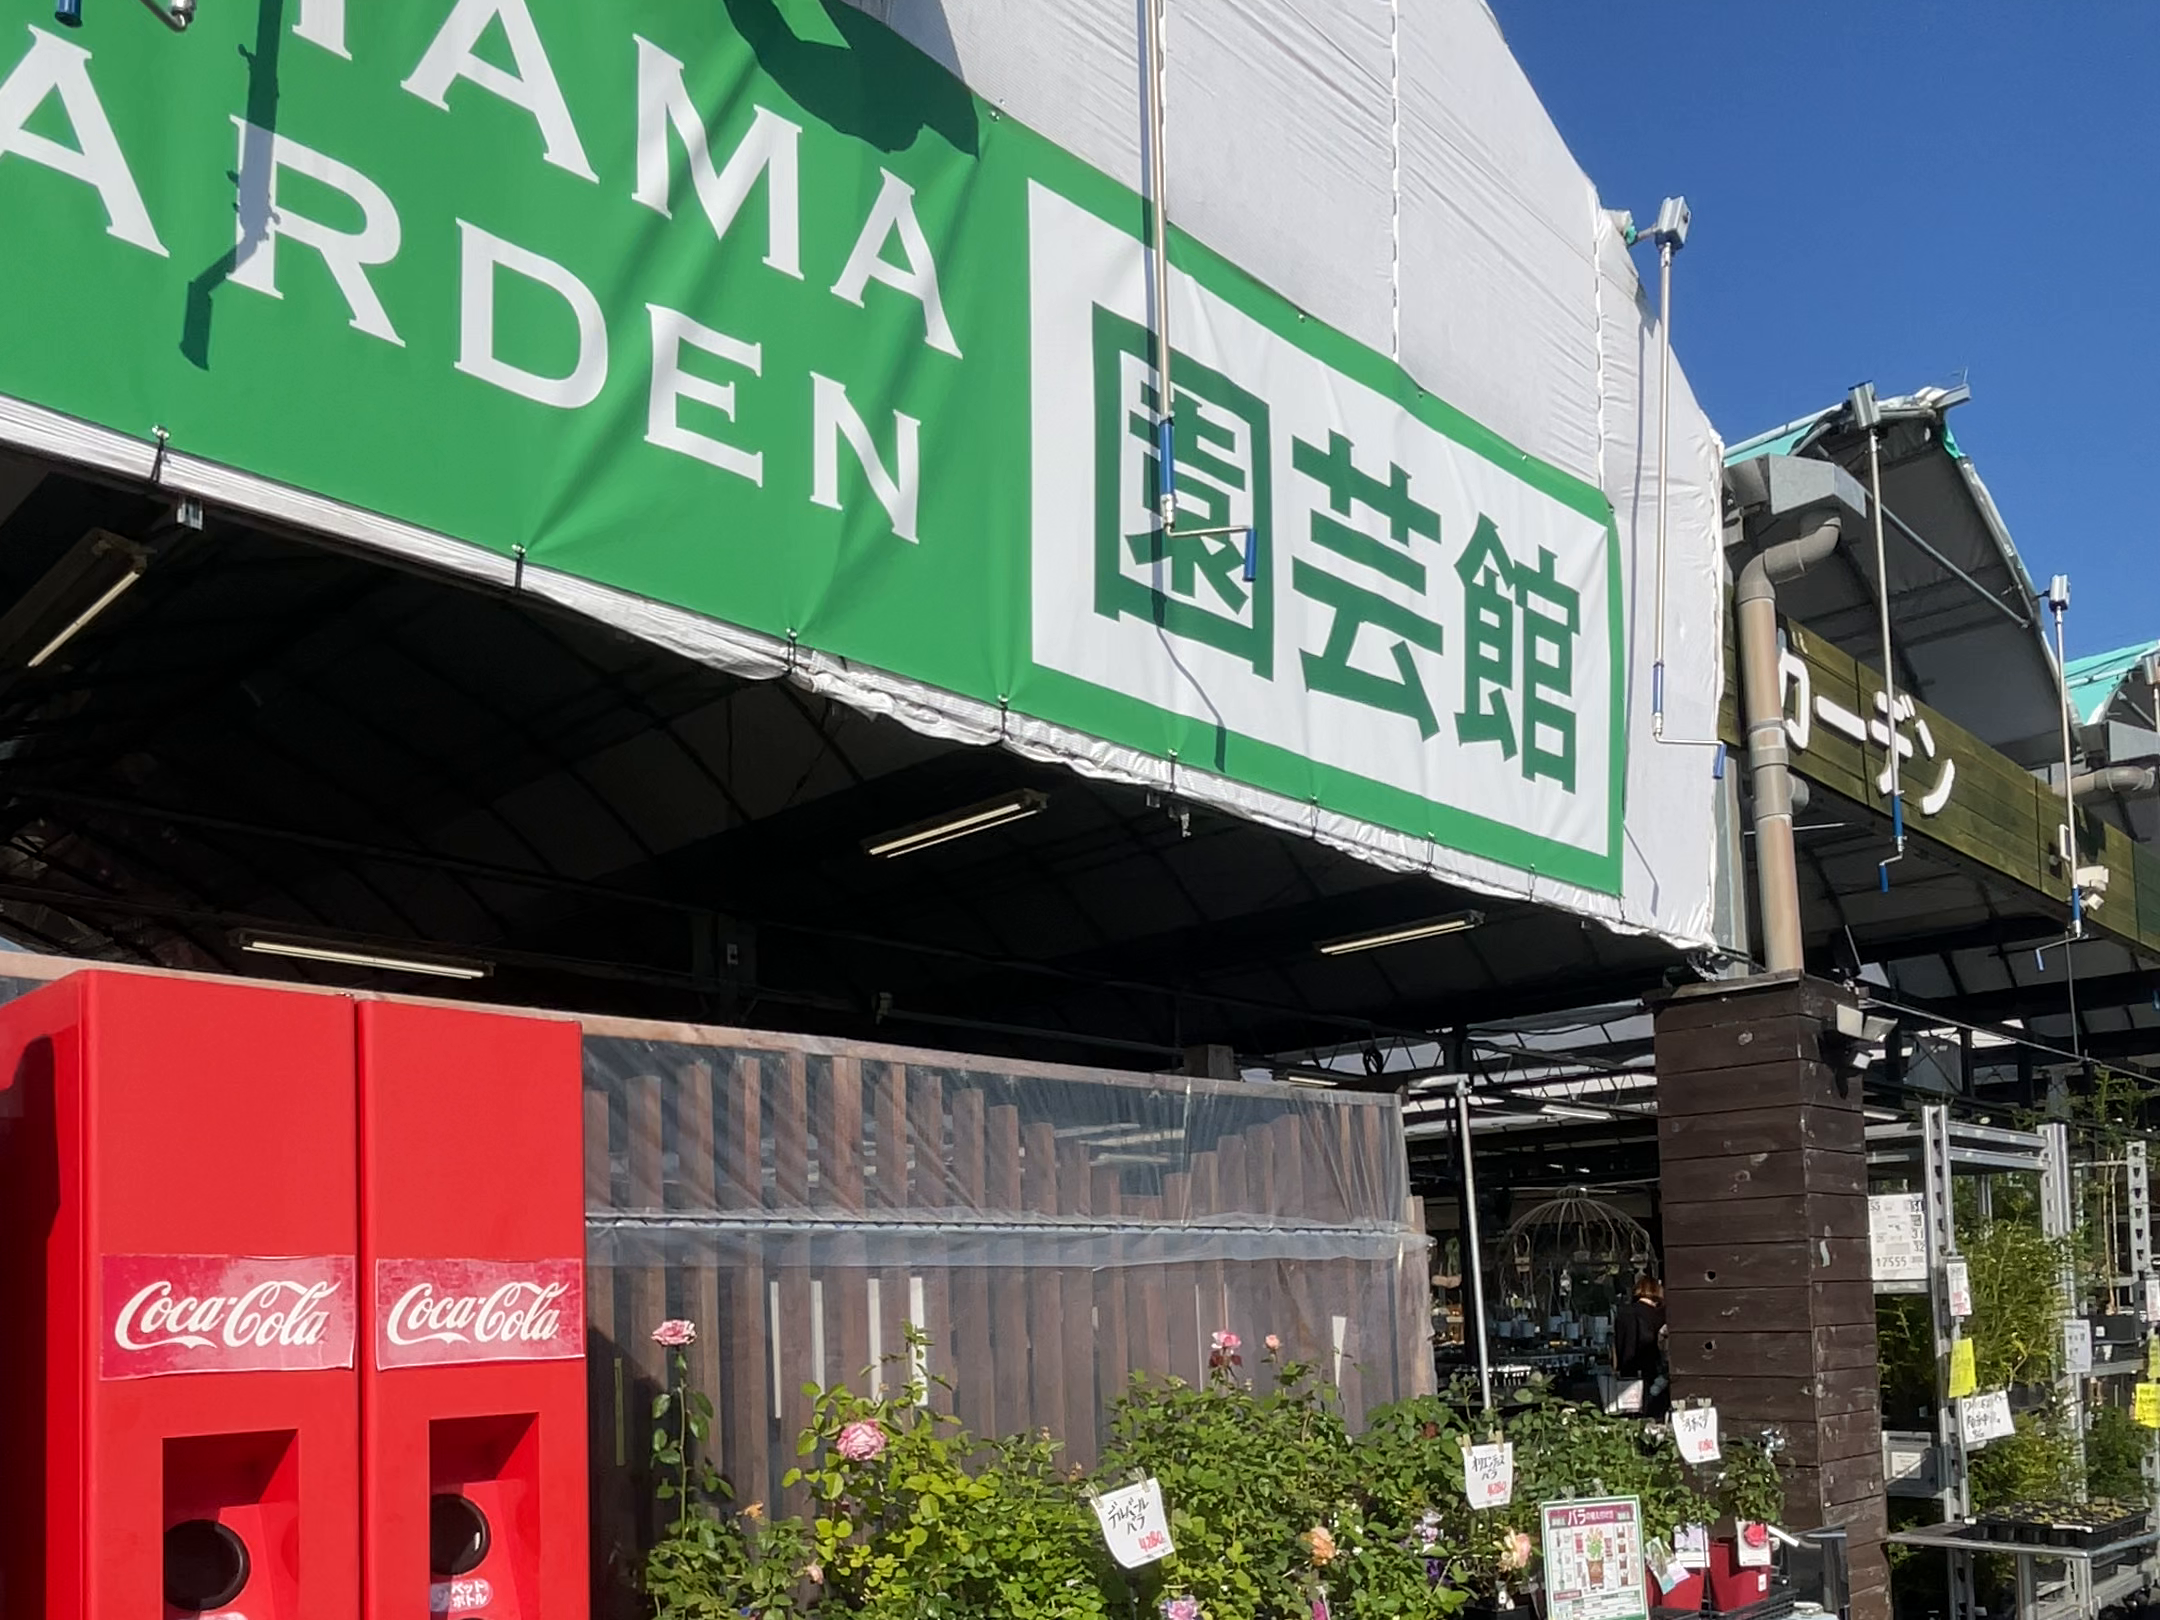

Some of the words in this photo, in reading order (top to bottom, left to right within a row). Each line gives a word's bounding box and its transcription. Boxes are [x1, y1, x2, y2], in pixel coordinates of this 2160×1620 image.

[1092, 301, 1581, 795] 園芸館
[115, 1280, 341, 1350] Coca-Cola
[387, 1281, 569, 1345] Coca-Cola
